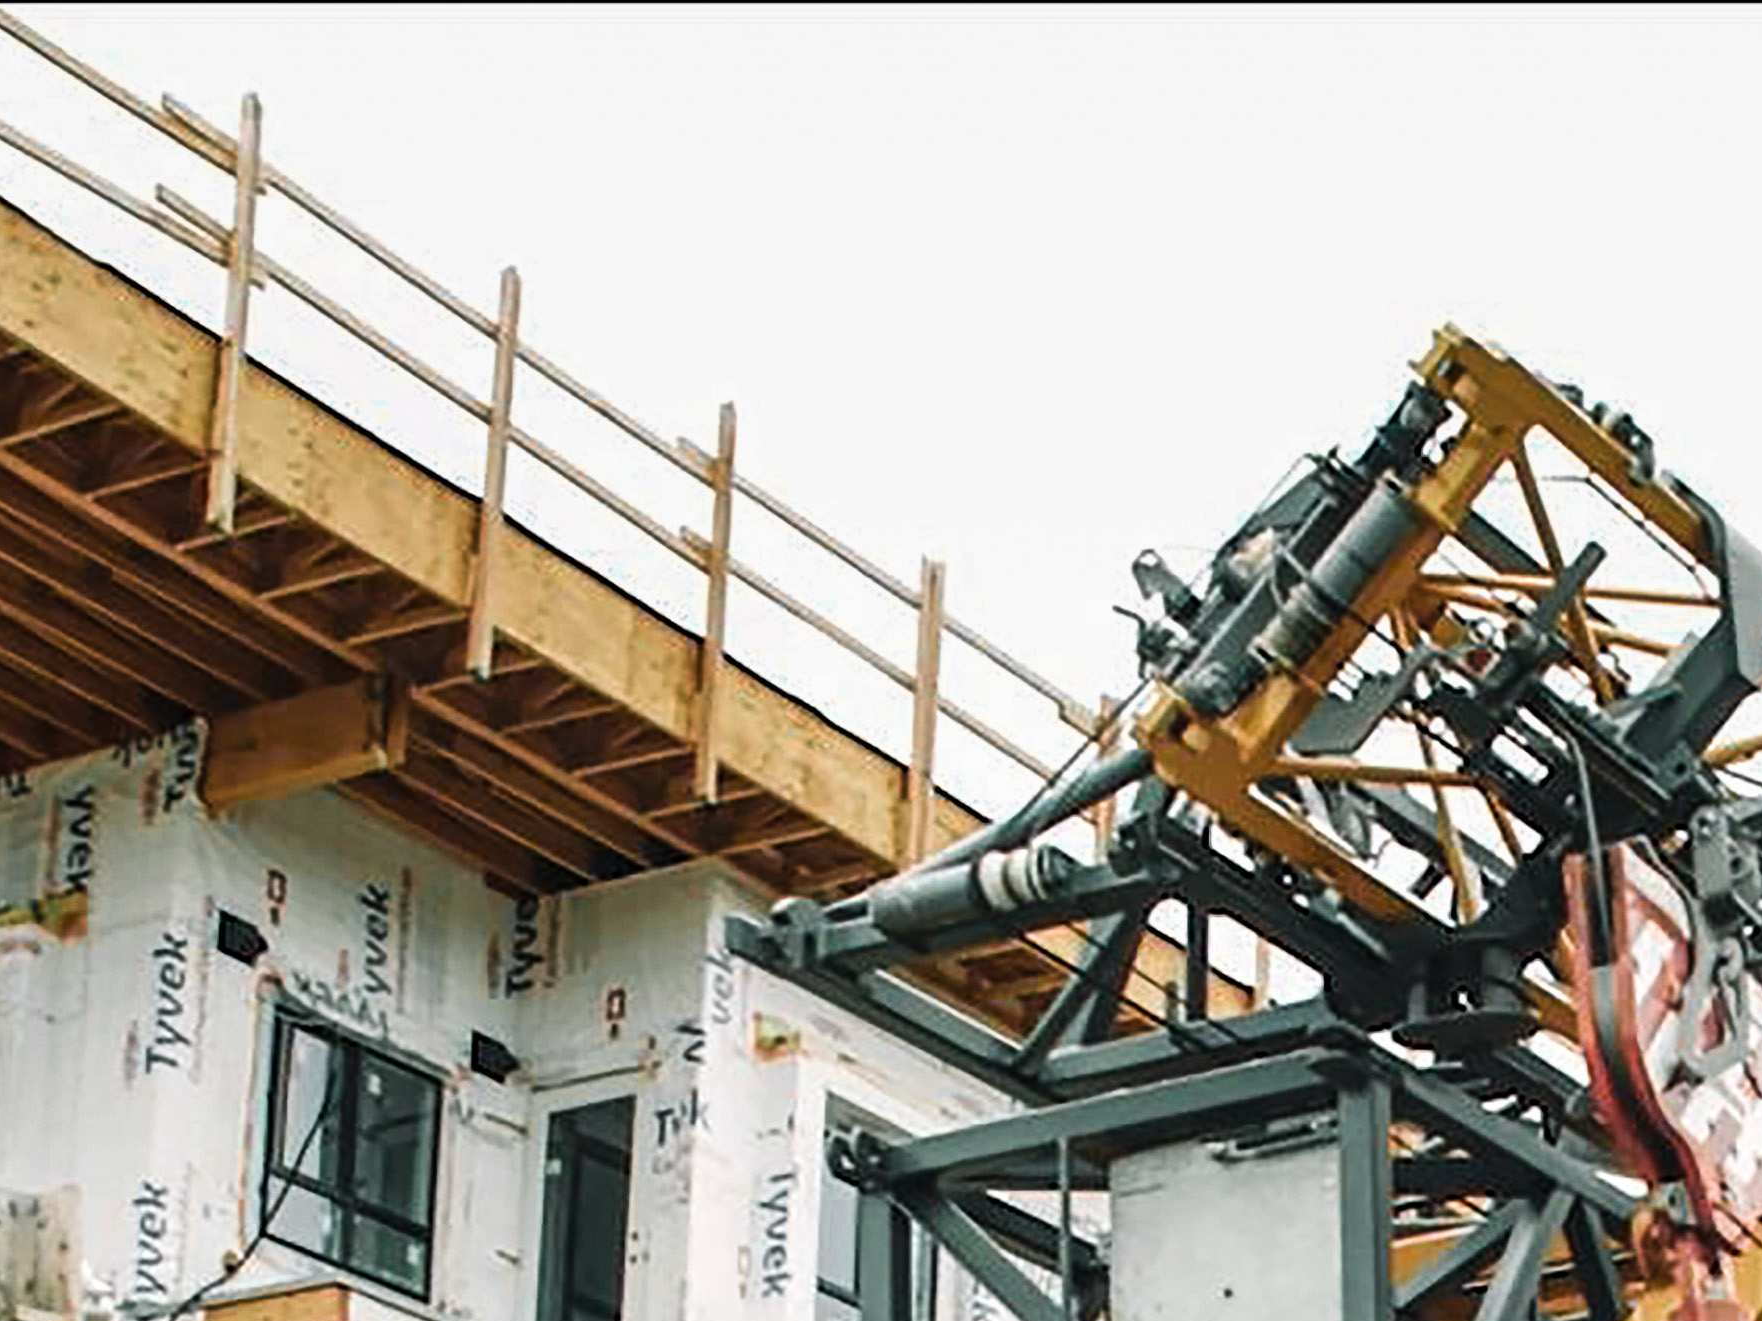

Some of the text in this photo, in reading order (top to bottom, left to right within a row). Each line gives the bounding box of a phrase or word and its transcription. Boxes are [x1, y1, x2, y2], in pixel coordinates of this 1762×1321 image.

[64, 785, 96, 895] yvek
[357, 884, 393, 1000] yvek
[505, 900, 544, 998] Tyve
[146, 933, 189, 1075] Tyvek
[133, 1180, 170, 1305] yvek
